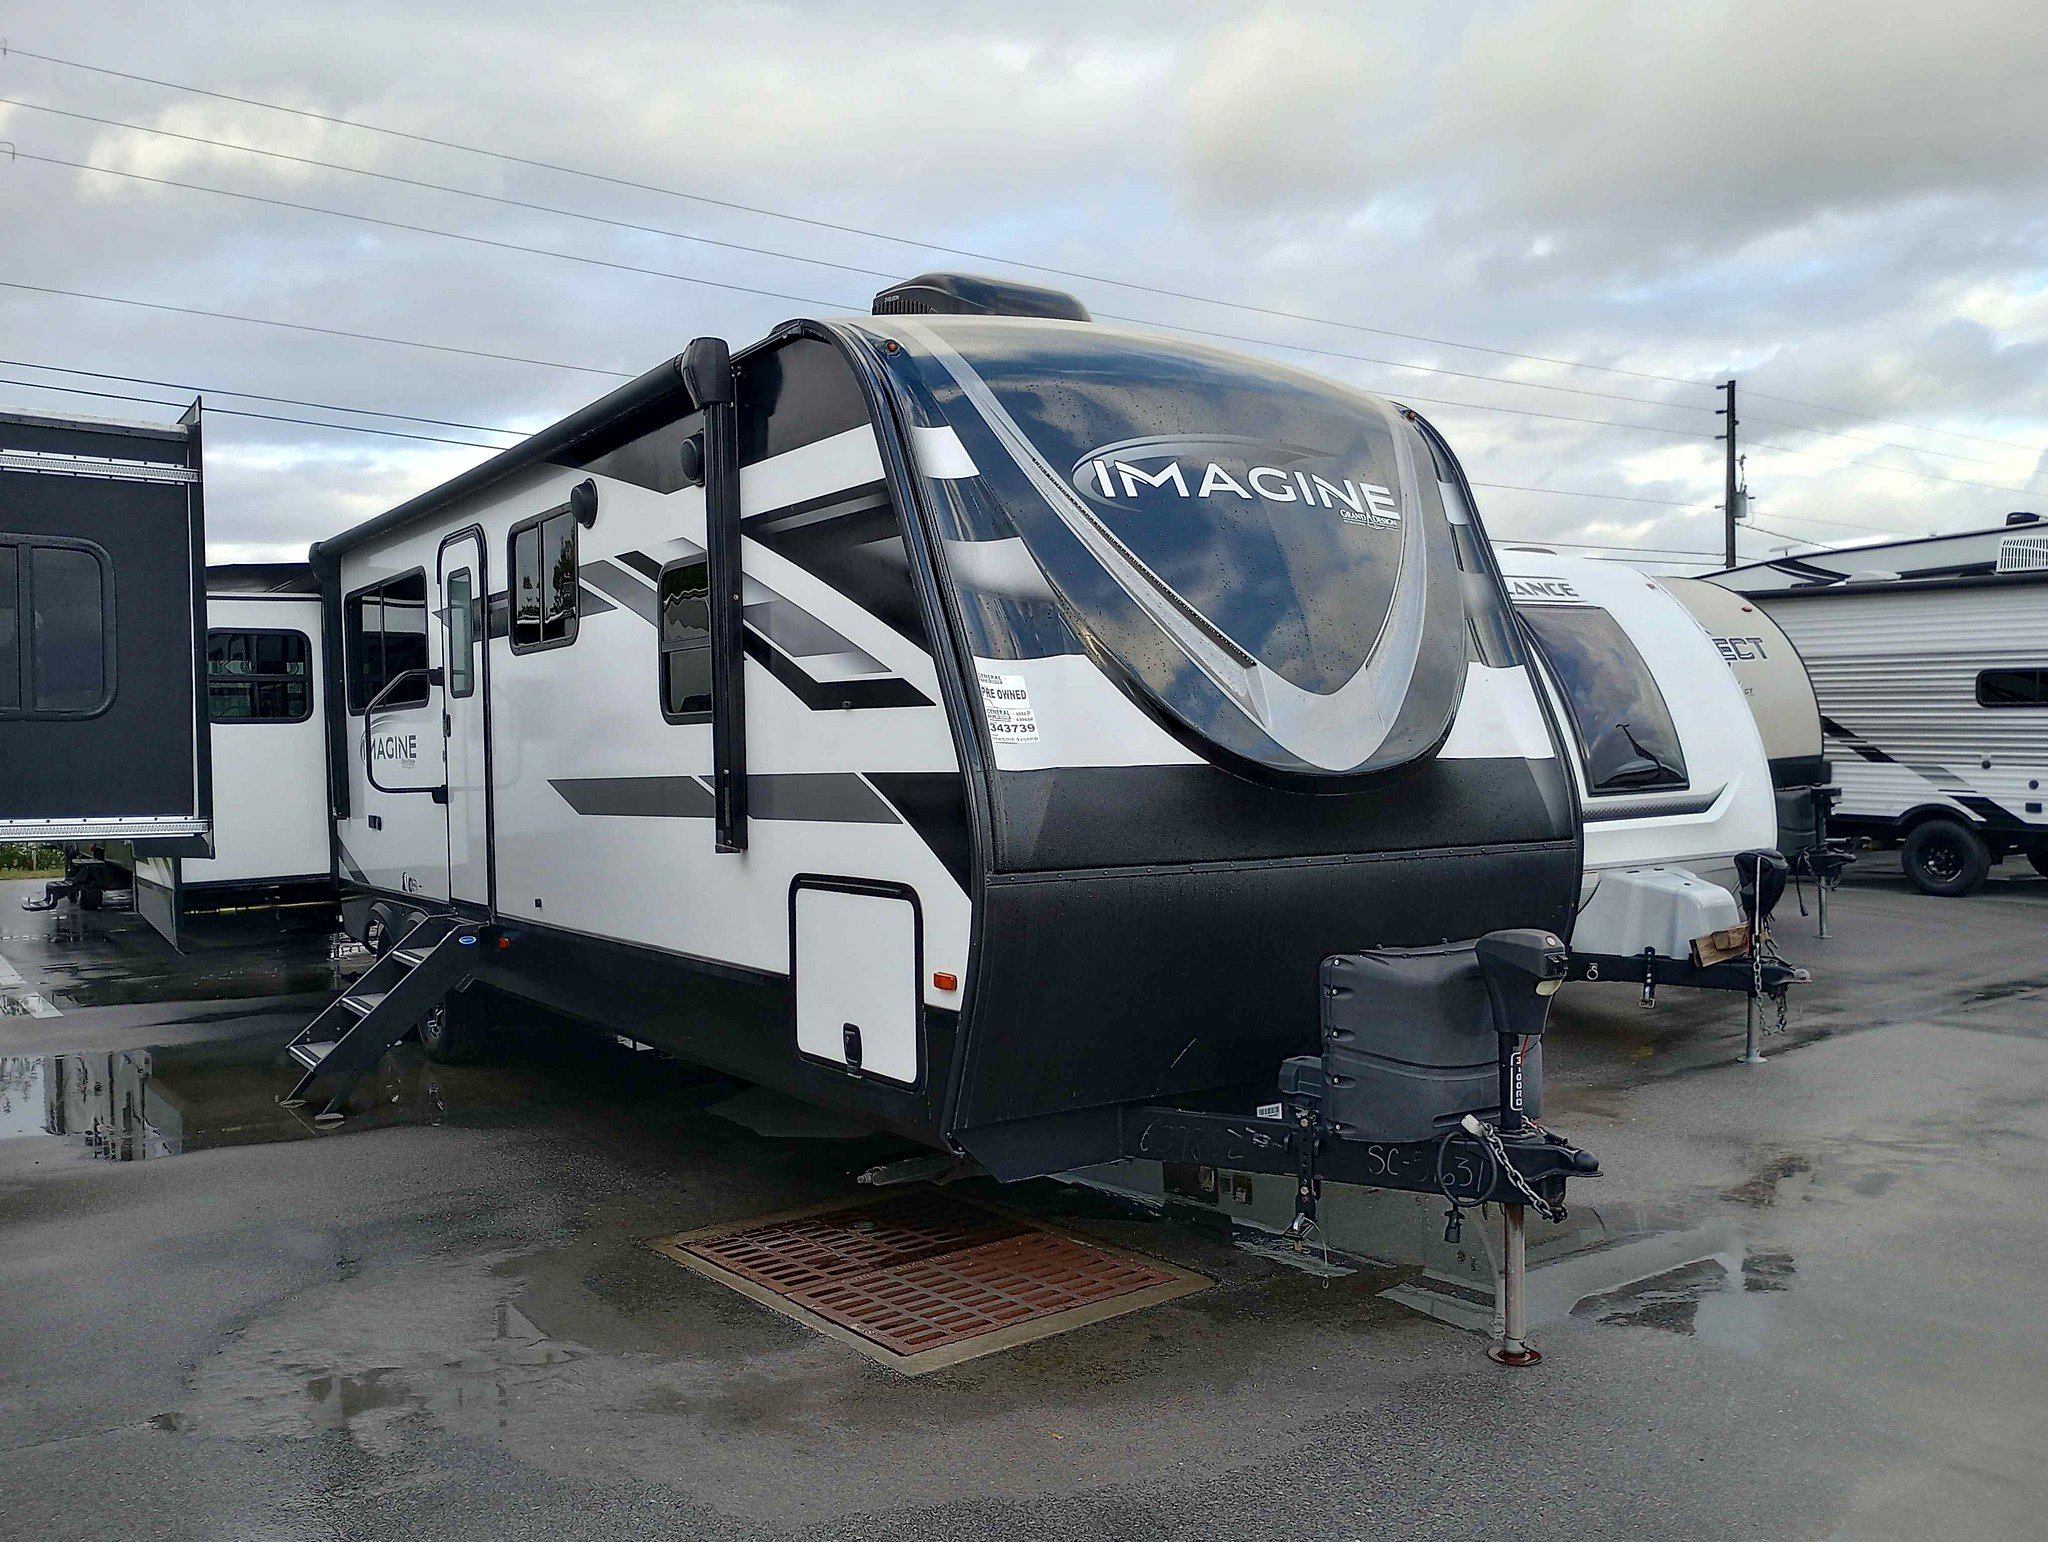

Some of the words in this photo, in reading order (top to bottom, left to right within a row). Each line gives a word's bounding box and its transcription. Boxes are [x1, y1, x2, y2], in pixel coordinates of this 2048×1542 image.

[1092, 458, 1401, 520] IMAGINE
[981, 686, 996, 699] PRE
[997, 689, 1027, 700] OWNED
[990, 722, 1036, 733] 343739
